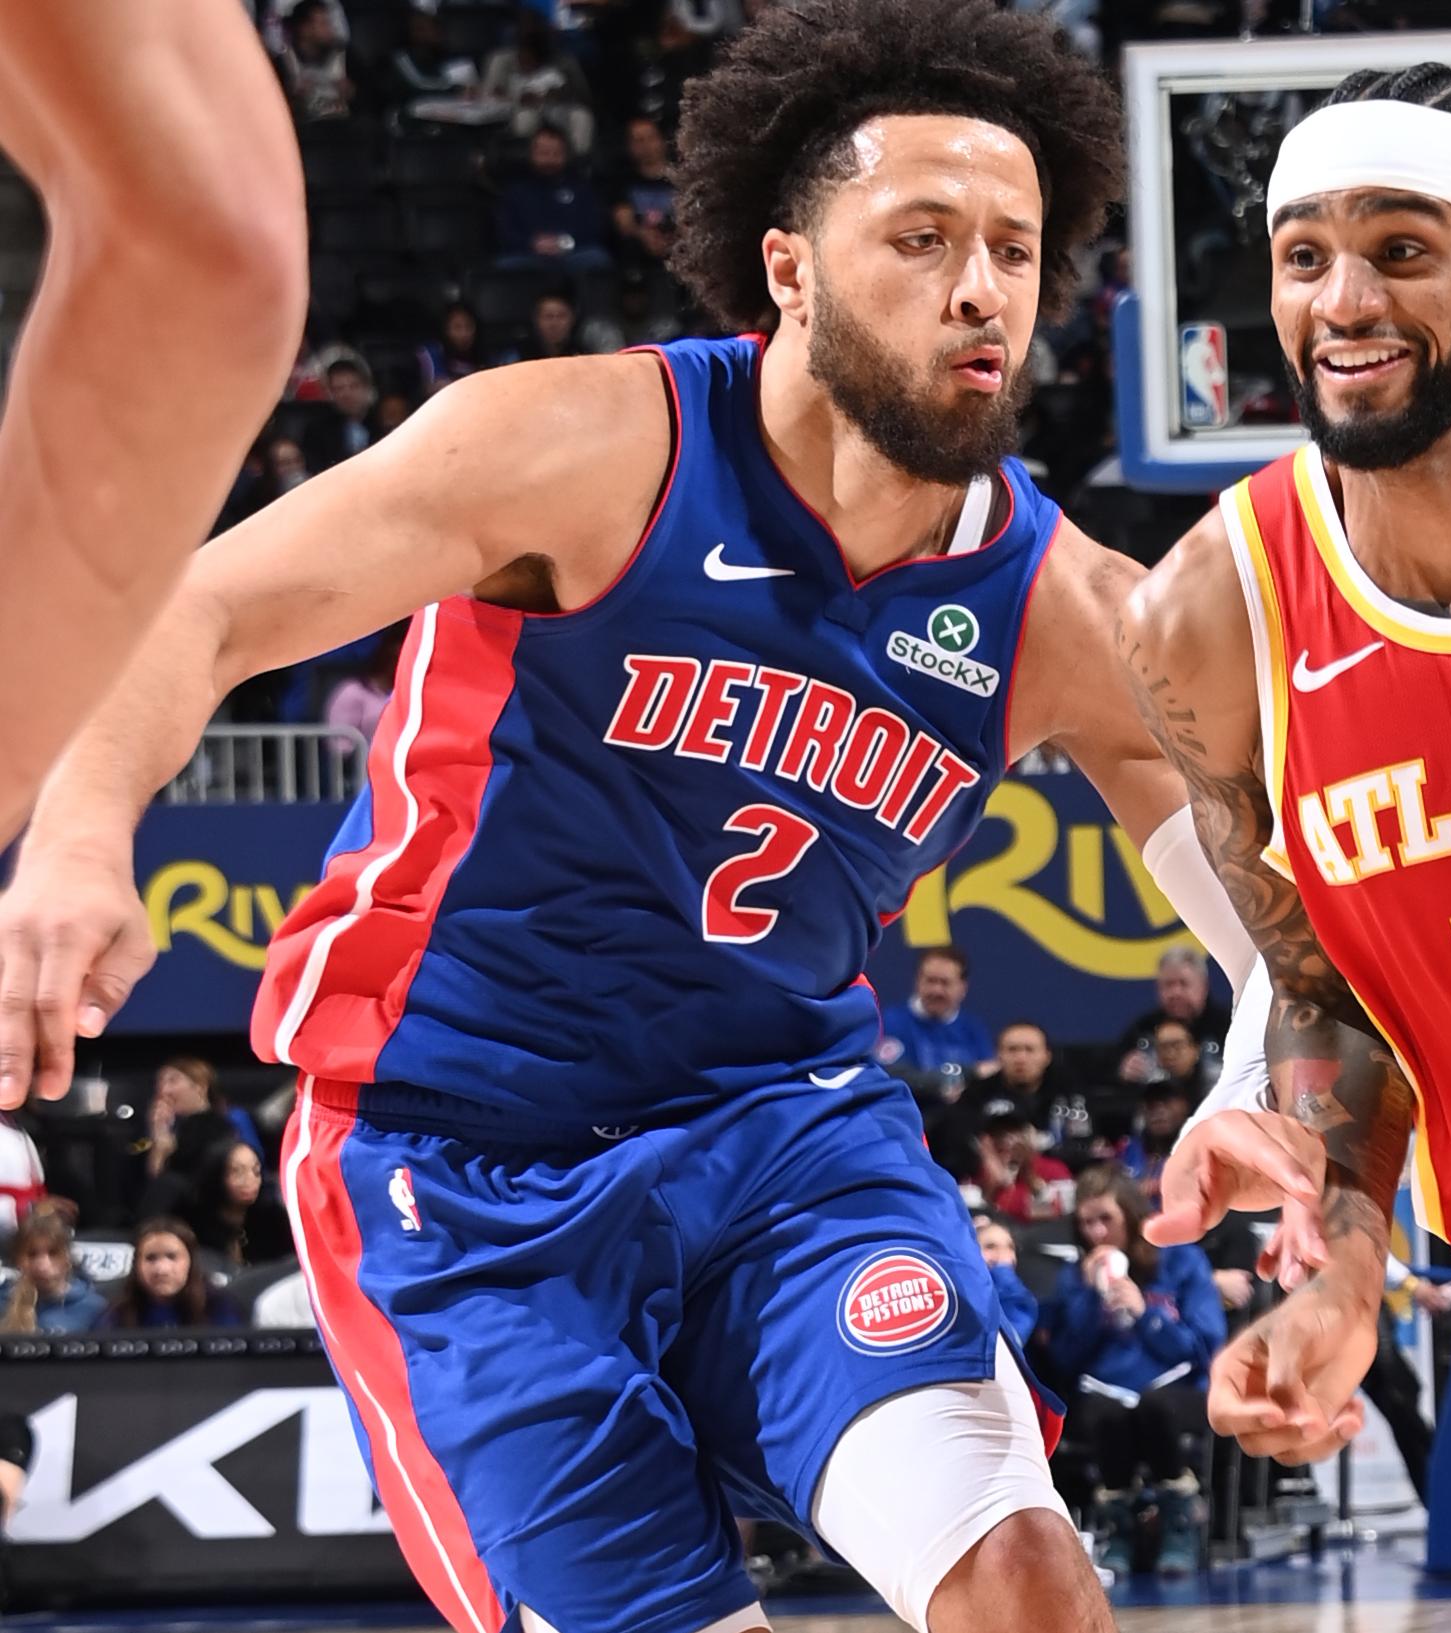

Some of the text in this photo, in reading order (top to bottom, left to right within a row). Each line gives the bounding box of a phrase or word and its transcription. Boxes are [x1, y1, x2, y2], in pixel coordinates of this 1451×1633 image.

[603, 653, 981, 846] DETROIT
[701, 803, 820, 944] 2
[858, 1277, 929, 1312] DETROIT
[861, 1293, 935, 1328] PISTONS
